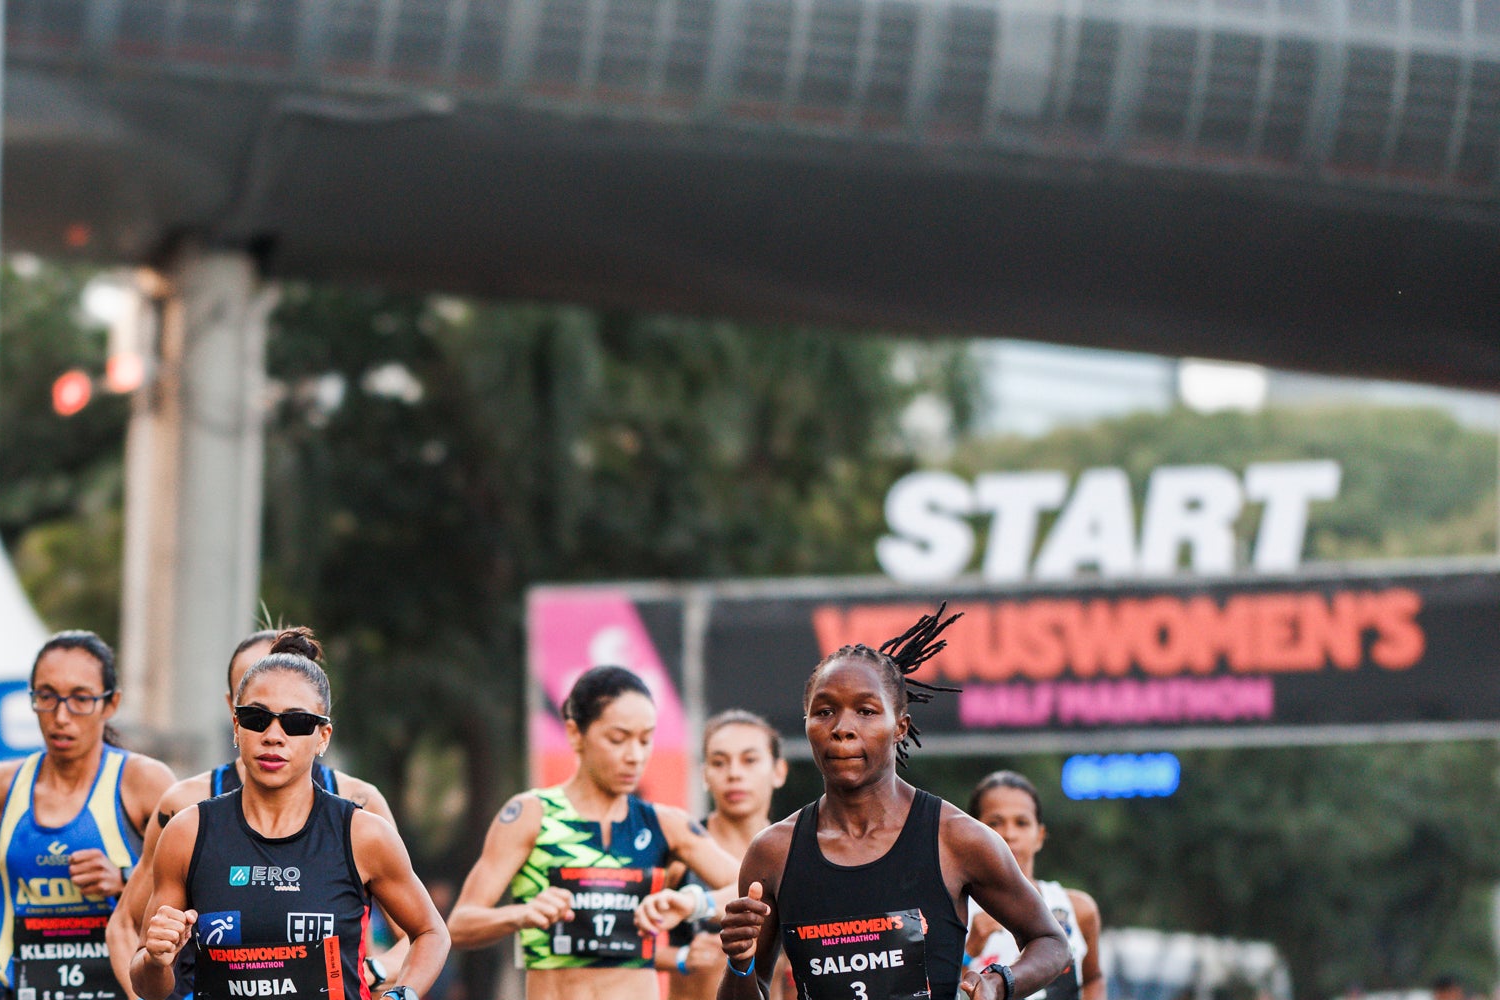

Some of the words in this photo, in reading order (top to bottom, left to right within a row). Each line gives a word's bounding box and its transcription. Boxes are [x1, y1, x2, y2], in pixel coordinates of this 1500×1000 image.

[874, 459, 1342, 582] START
[592, 914, 616, 937] 17
[797, 916, 903, 939] VENUSWOMEN'S
[821, 938, 839, 946] HALF
[840, 933, 880, 944] MARATHON
[20, 943, 109, 960] KLEIDIAN
[208, 945, 307, 962] VENUSWOMEN'S
[246, 961, 284, 969] MARATHON
[809, 949, 905, 976] SALOME
[57, 964, 85, 987] 16
[228, 977, 298, 997] NUBIA
